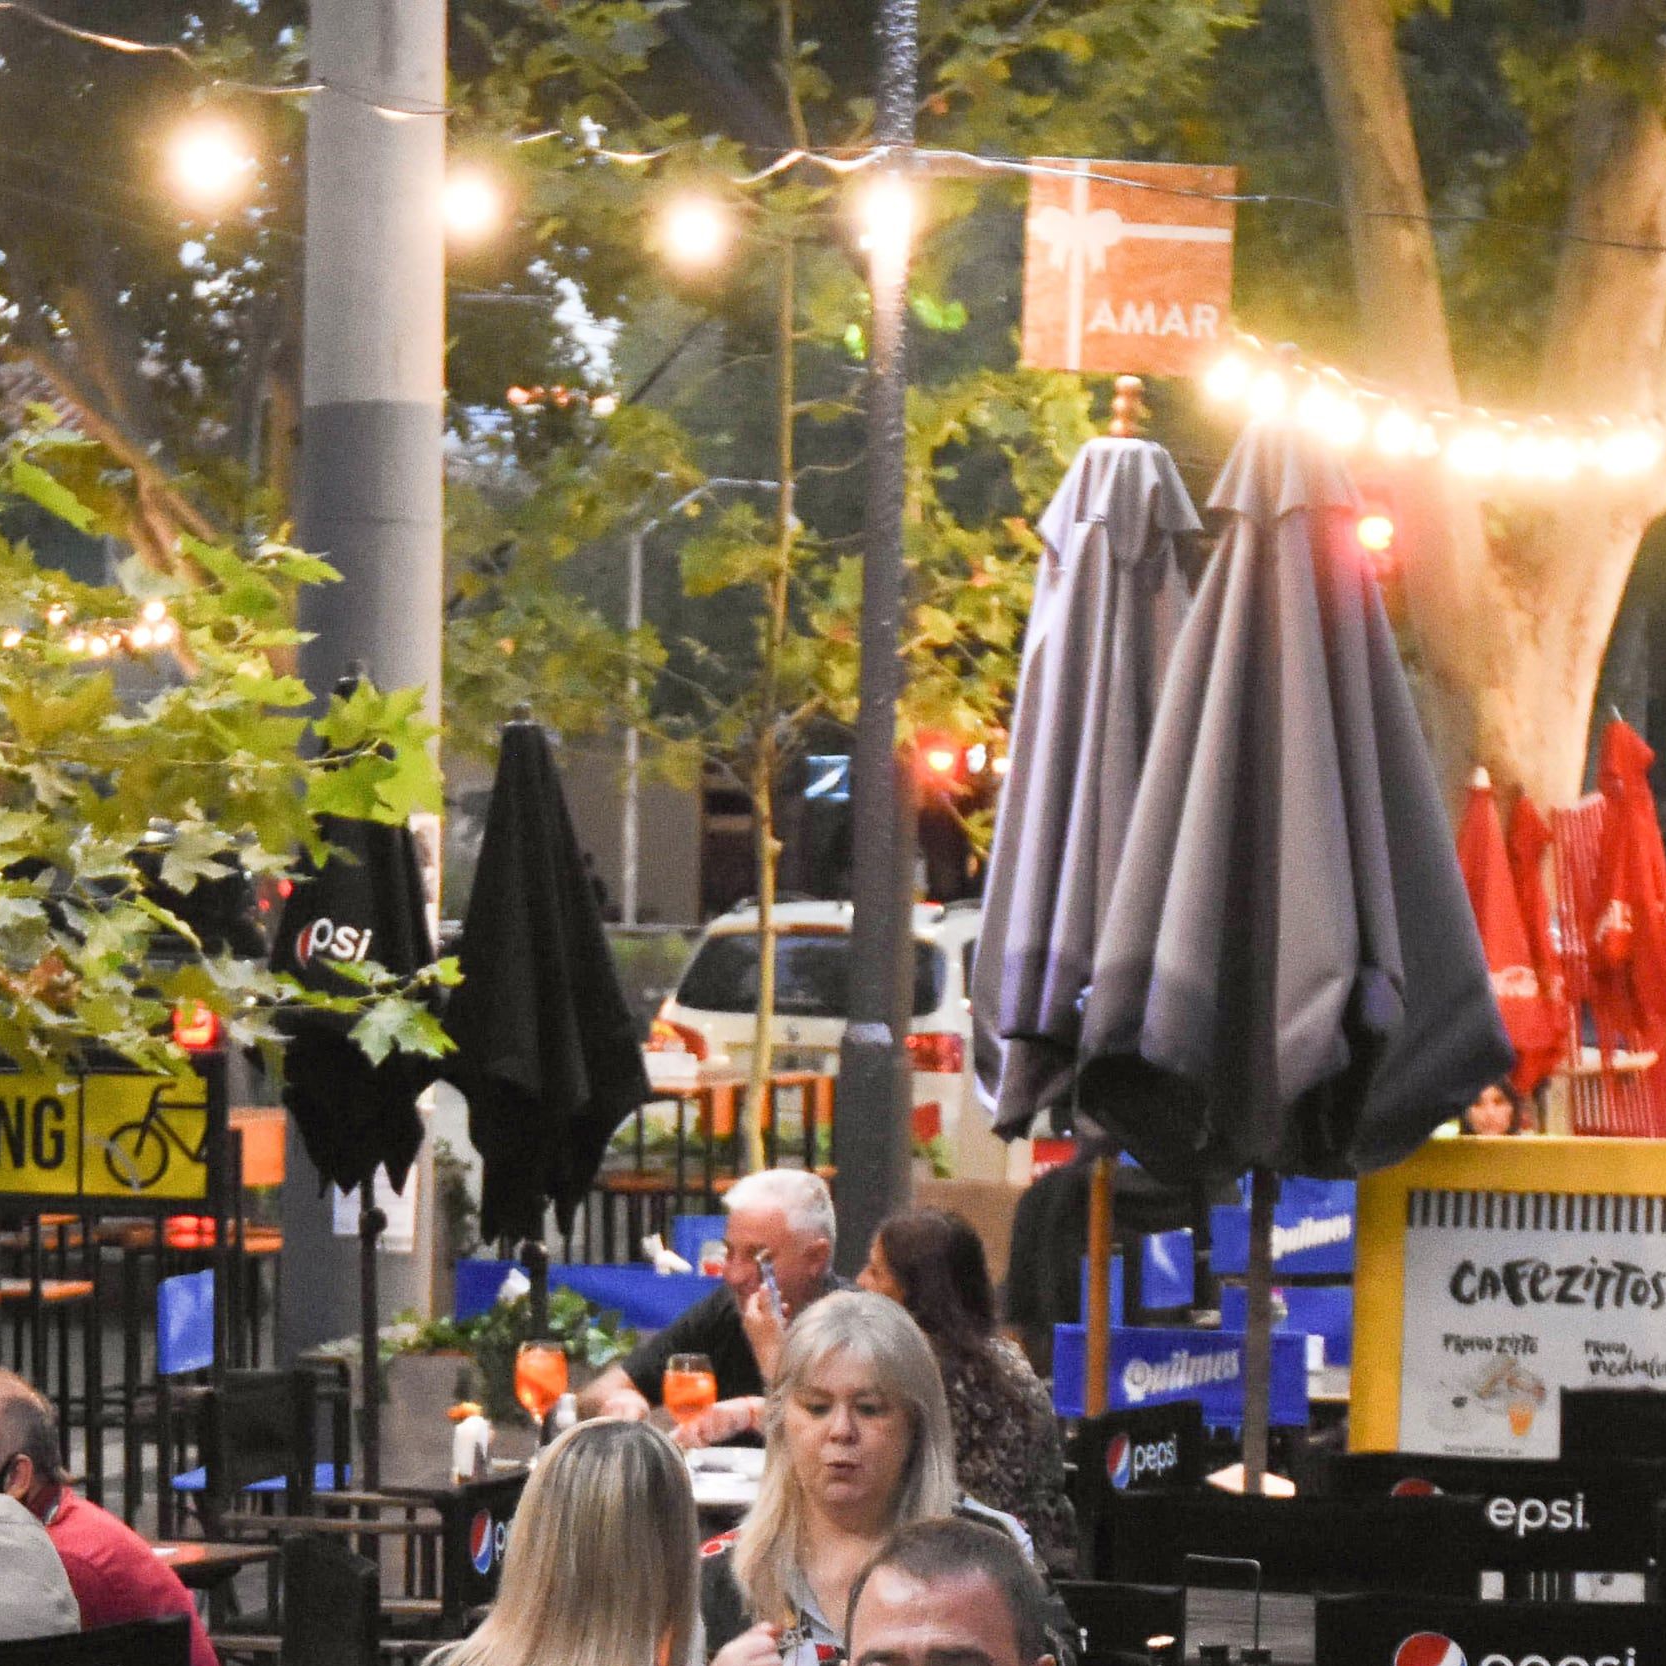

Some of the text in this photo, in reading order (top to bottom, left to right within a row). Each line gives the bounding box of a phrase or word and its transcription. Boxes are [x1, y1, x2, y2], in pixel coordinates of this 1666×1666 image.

[1086, 299, 1220, 339] AMAR
[307, 916, 373, 963] psi
[1131, 1432, 1179, 1482] pepsi
[1485, 1491, 1587, 1539] epsi
